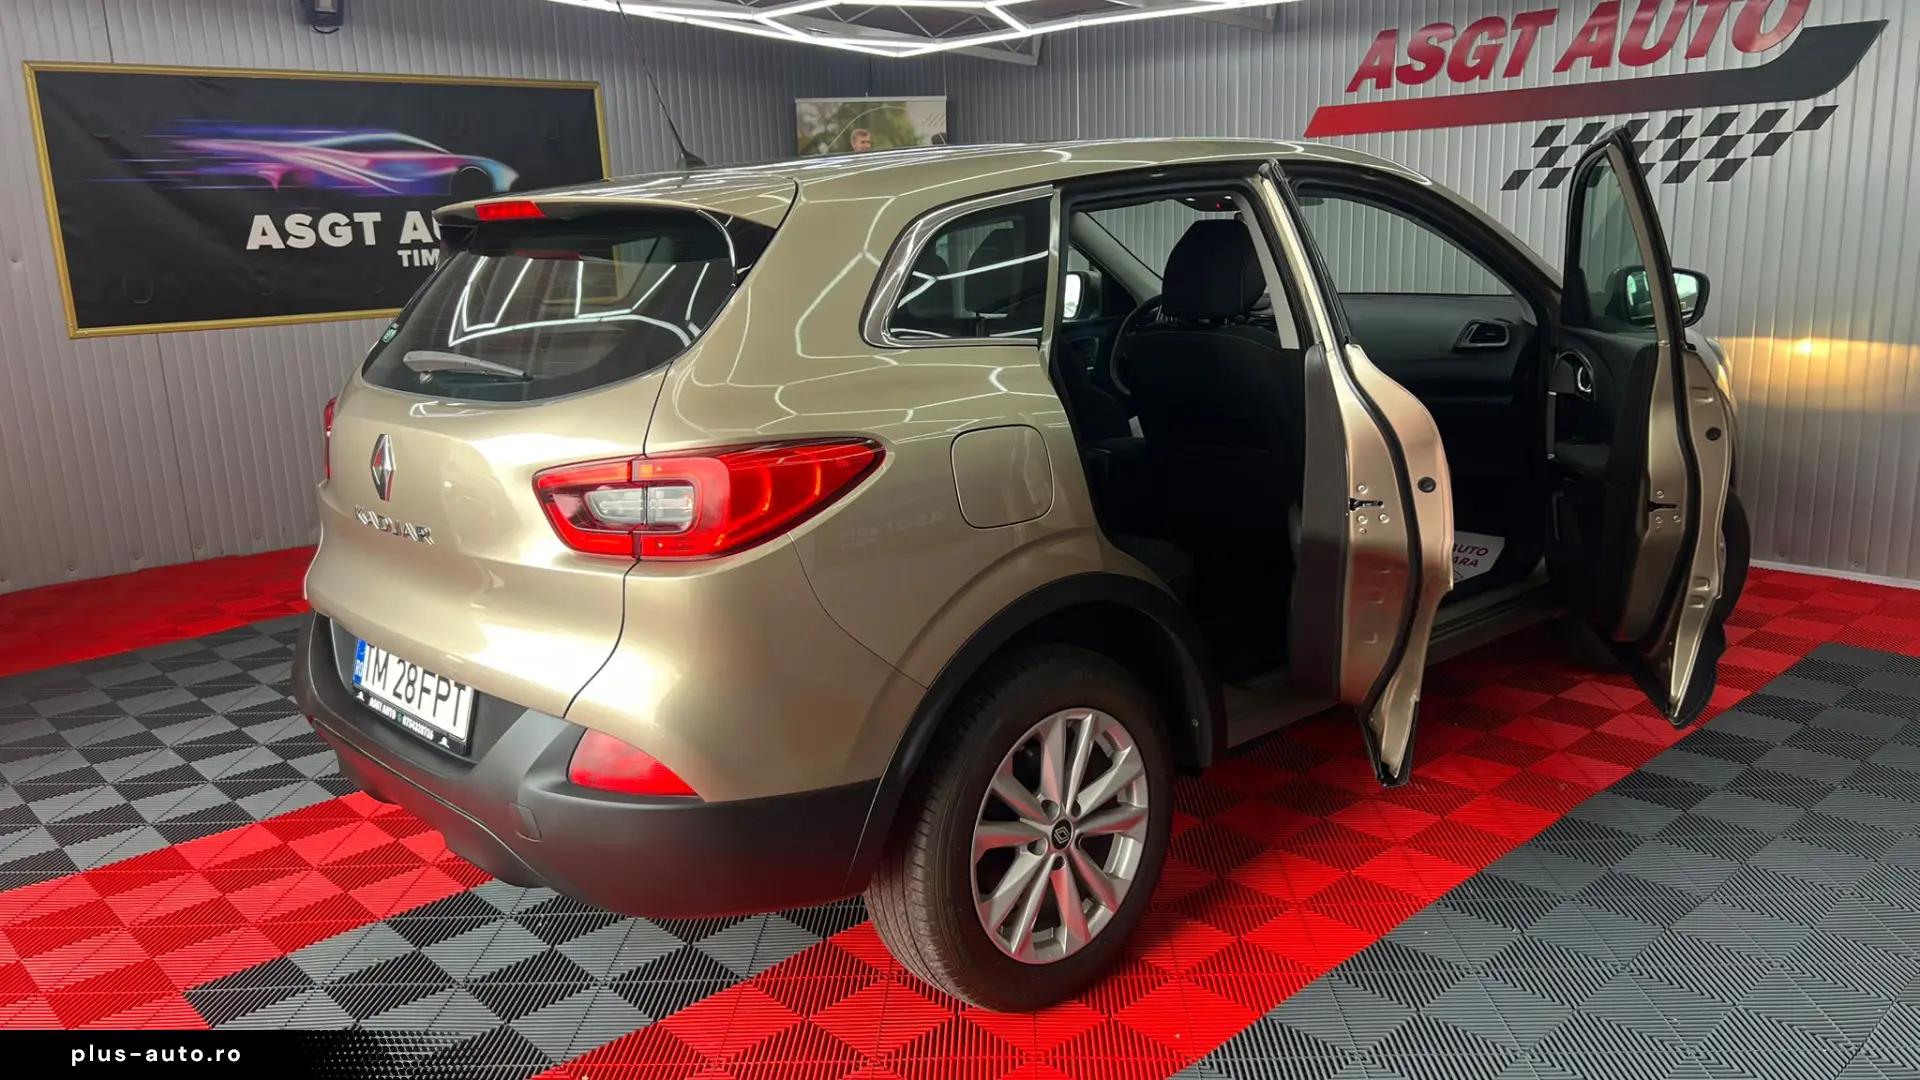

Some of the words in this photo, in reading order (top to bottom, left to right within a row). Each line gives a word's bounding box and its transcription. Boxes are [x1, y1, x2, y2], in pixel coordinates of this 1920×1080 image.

[1345, 8, 1559, 93] ASGT
[1552, 0, 1808, 74] AUTO
[246, 212, 382, 250] ASGT
